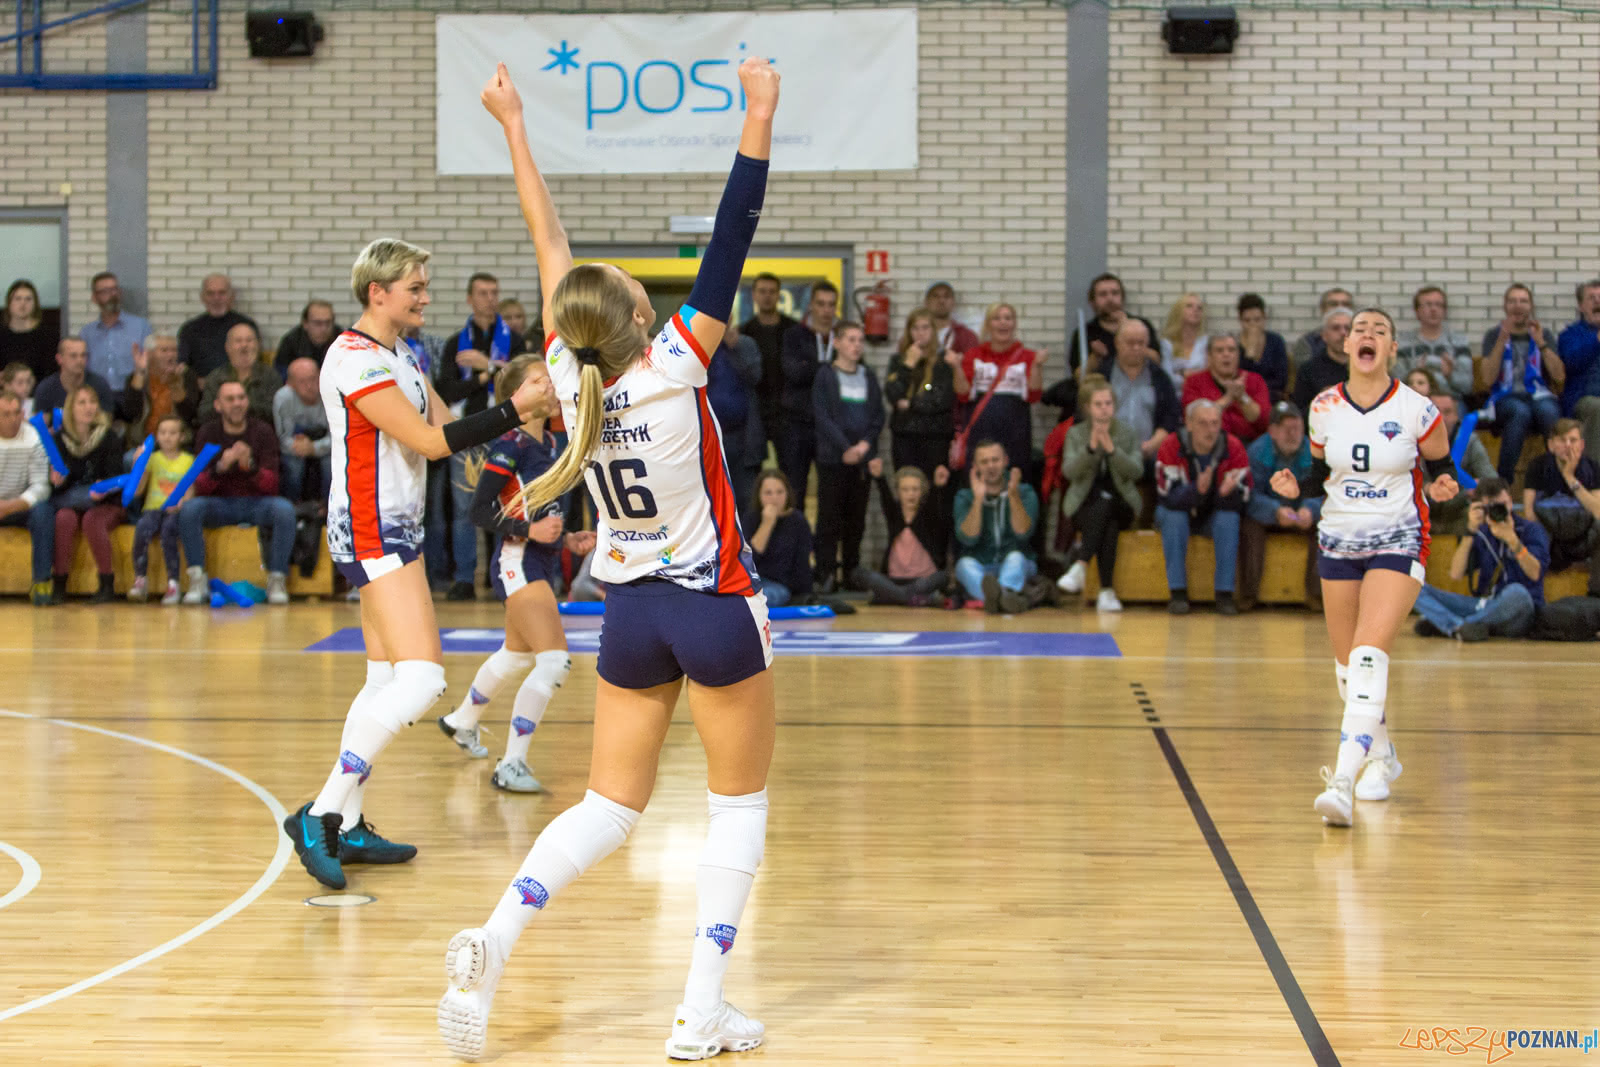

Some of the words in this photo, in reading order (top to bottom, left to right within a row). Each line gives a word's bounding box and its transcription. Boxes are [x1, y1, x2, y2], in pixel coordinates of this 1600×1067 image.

[586, 42, 776, 131] posi
[1352, 443, 1370, 473] 9
[584, 459, 659, 519] 16
[1345, 486, 1388, 499] Enea
